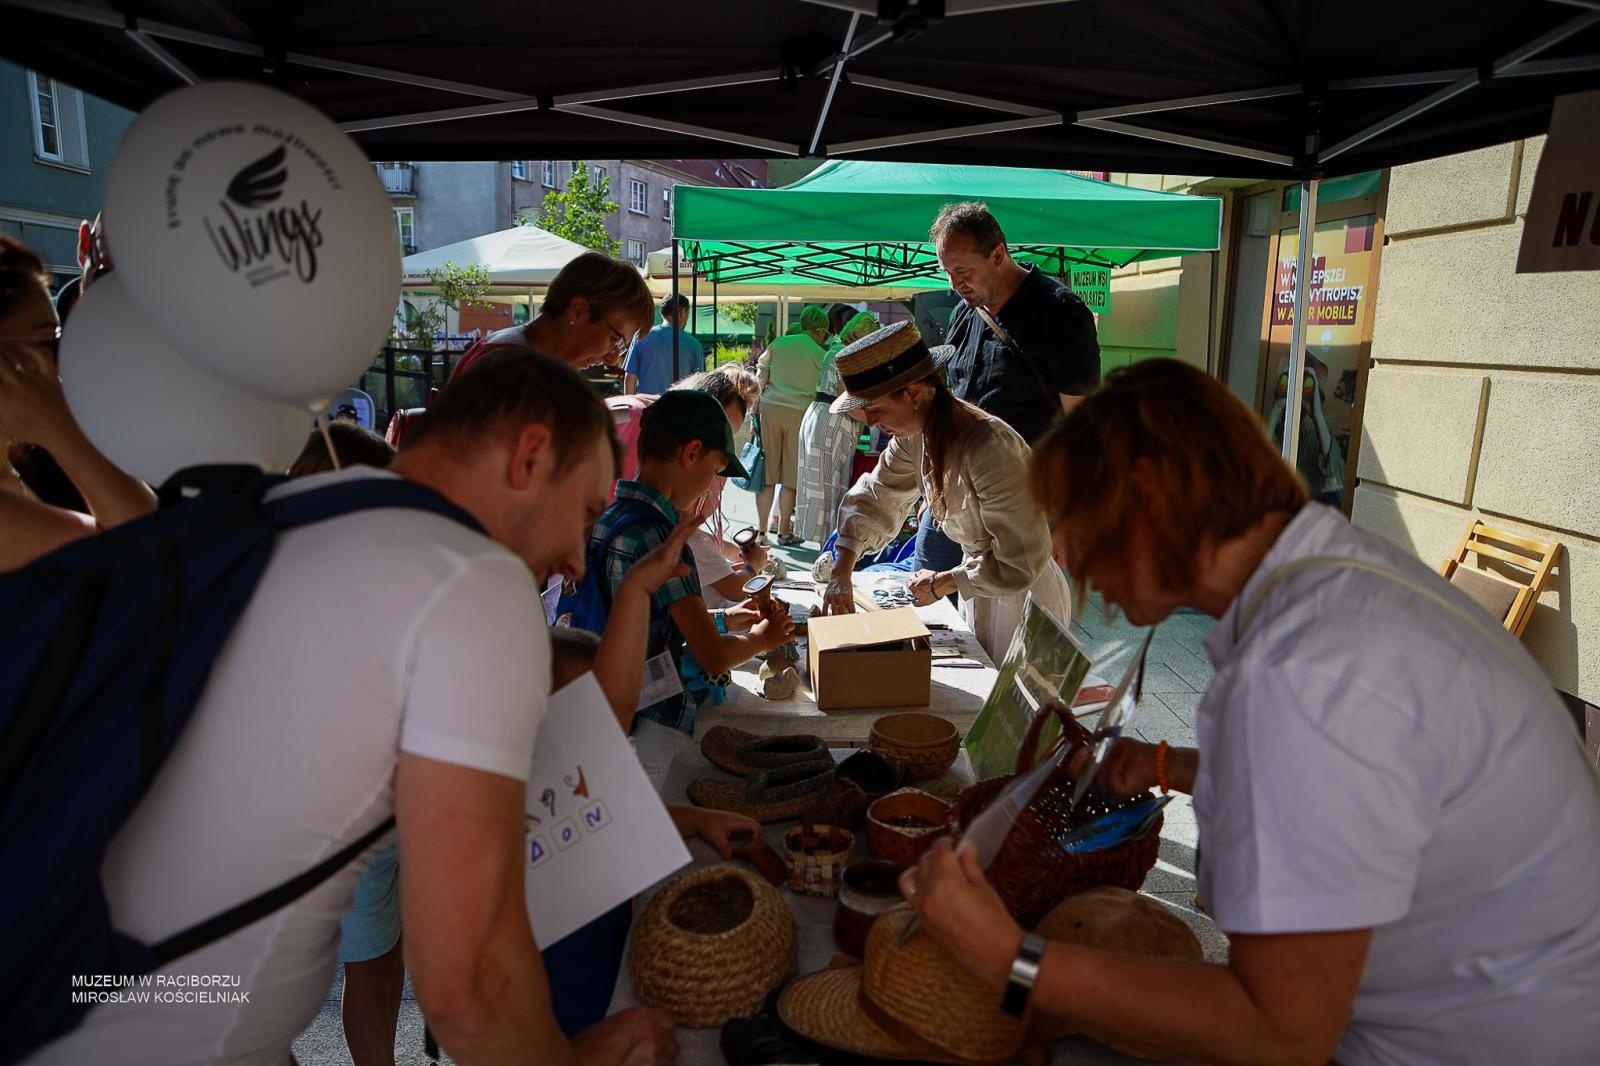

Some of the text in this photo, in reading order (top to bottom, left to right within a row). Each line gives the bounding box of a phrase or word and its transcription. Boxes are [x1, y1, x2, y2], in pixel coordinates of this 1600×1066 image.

[202, 199, 323, 284] Wings
[1074, 270, 1097, 286] MUZEUM
[1317, 306, 1354, 320] MOBILE
